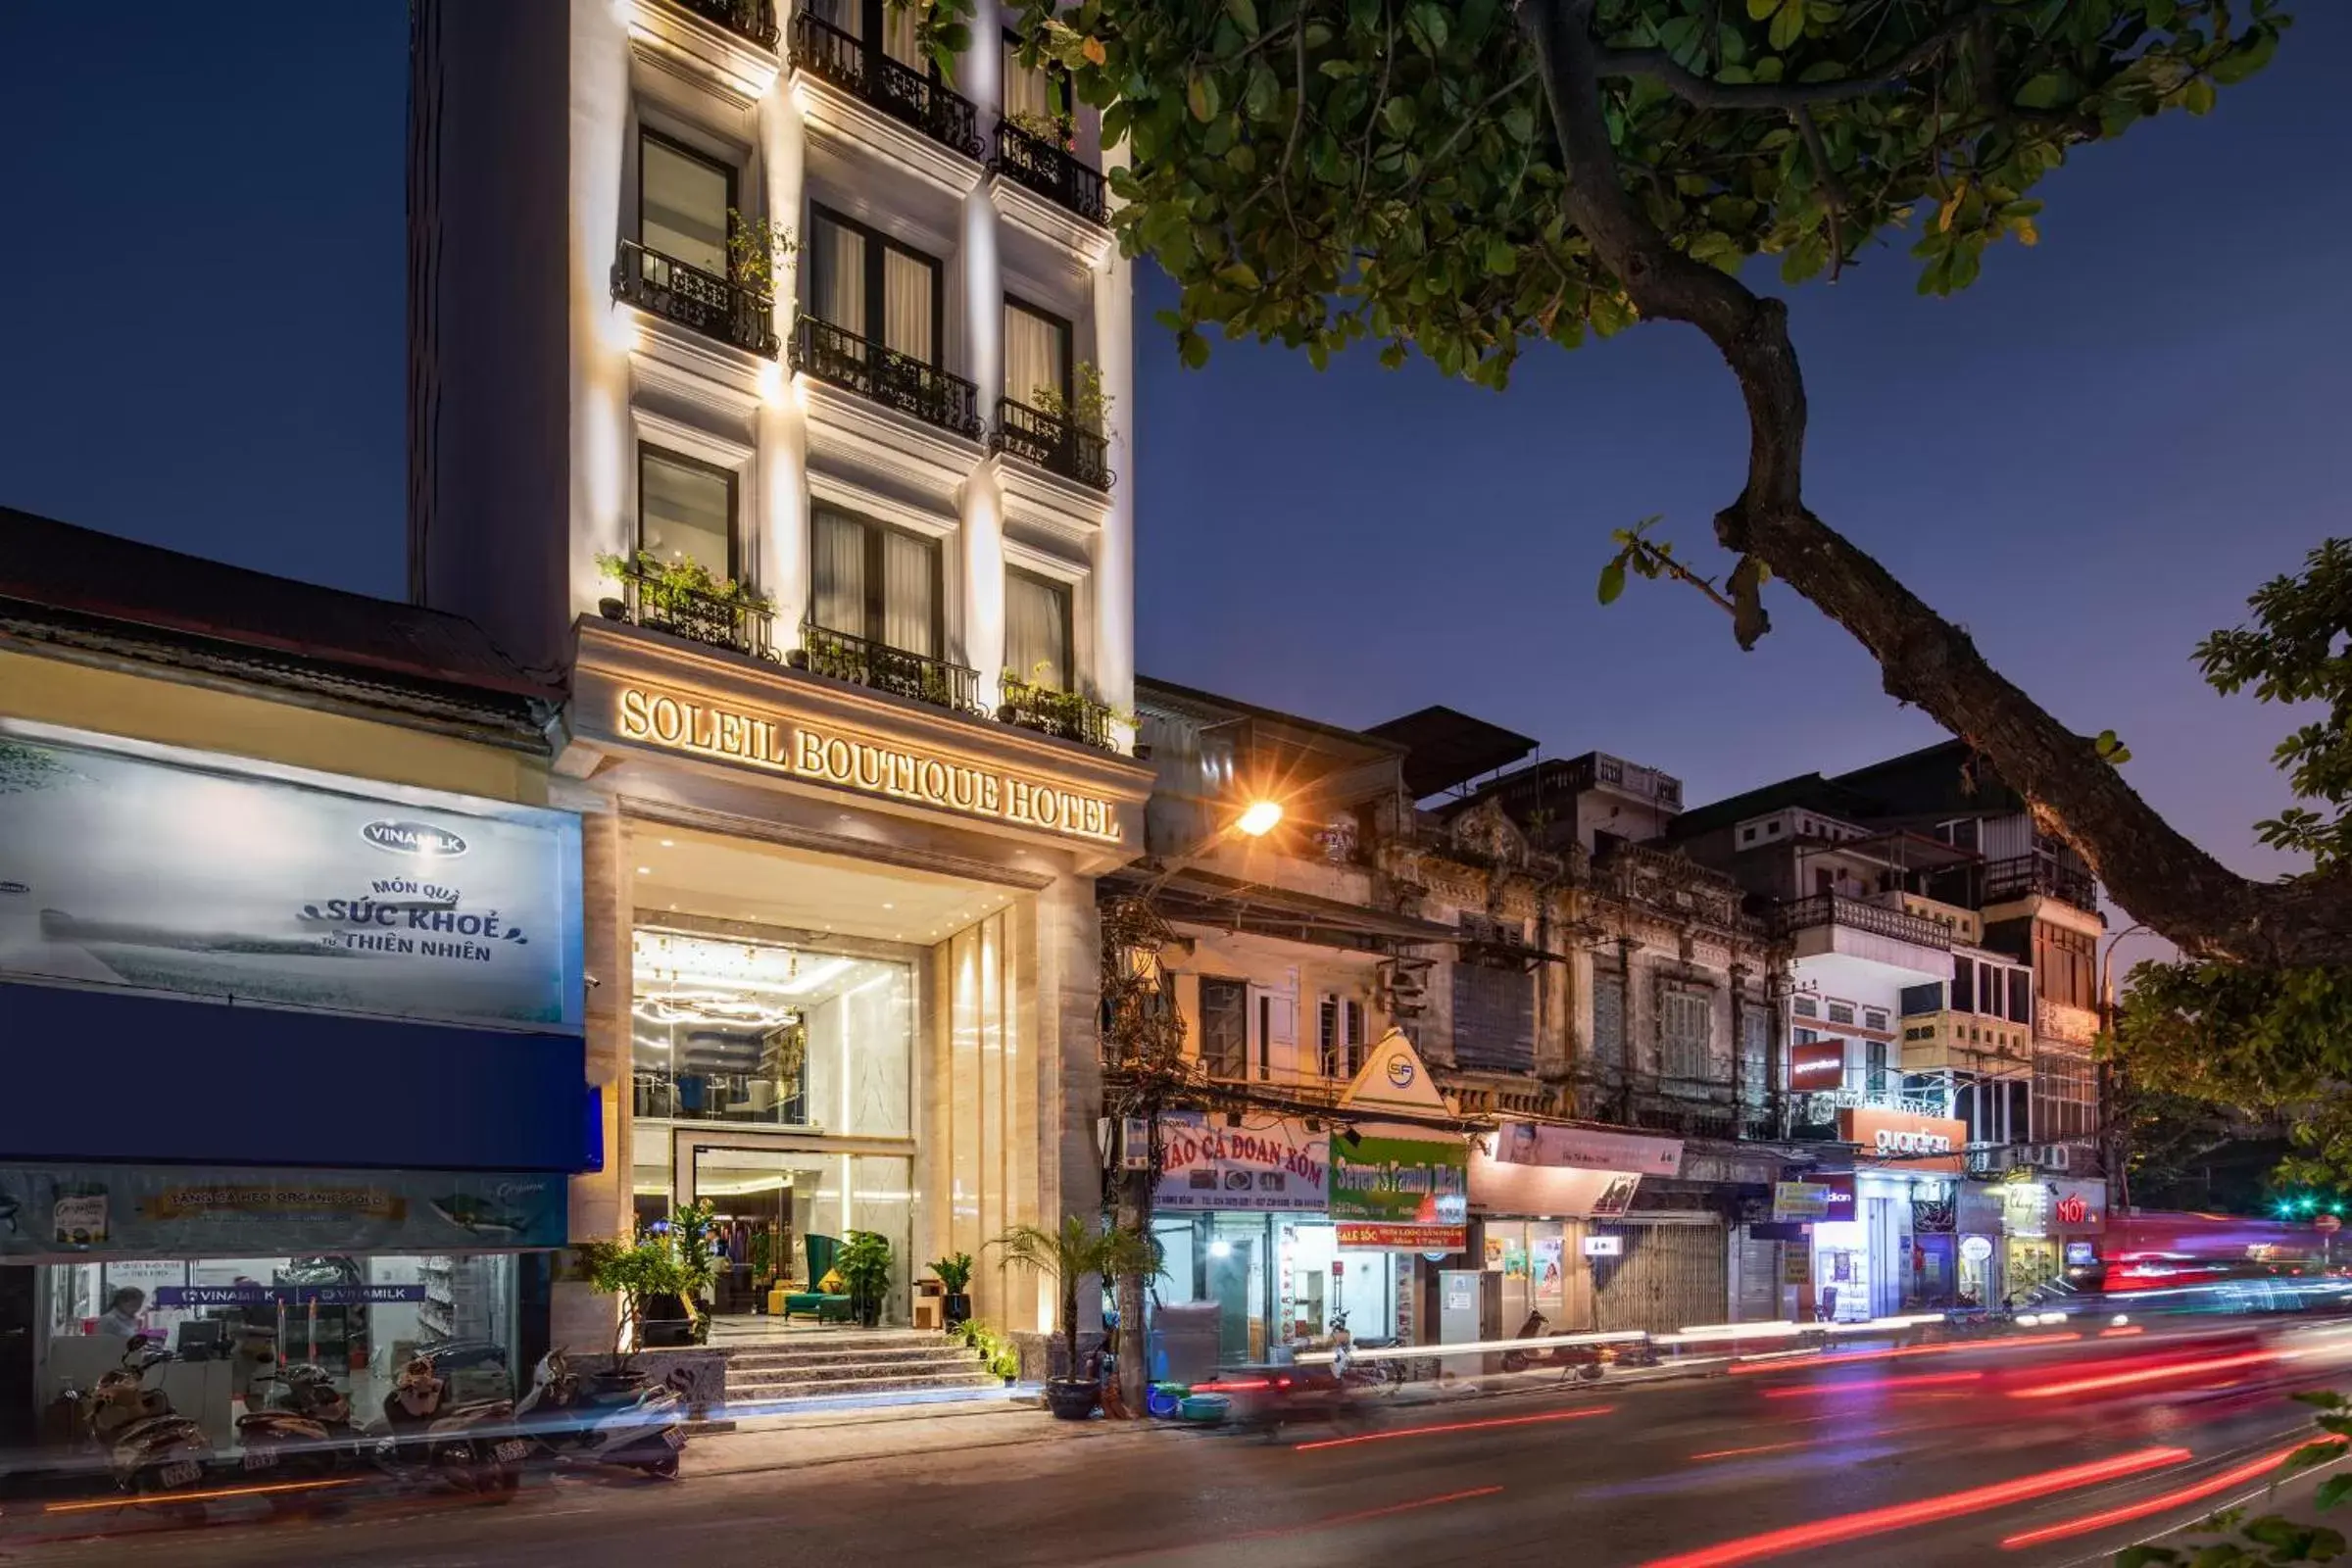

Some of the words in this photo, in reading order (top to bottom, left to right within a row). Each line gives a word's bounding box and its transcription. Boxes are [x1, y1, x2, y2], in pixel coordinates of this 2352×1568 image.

[622, 689, 786, 765] SOLEIL
[798, 729, 1000, 812] BOUTIQUE
[1007, 778, 1120, 839] HOTEL
[369, 826, 461, 852] VINALK
[371, 876, 417, 894] MÓN
[326, 896, 398, 926] SỨC
[408, 907, 501, 938] KHOẺ
[346, 932, 413, 954] THIÊN
[421, 941, 491, 961] NHIÊN
[1201, 1128, 1227, 1160] CÁ
[1876, 1126, 1949, 1155] guardian
[201, 1291, 274, 1301] VINAMIK
